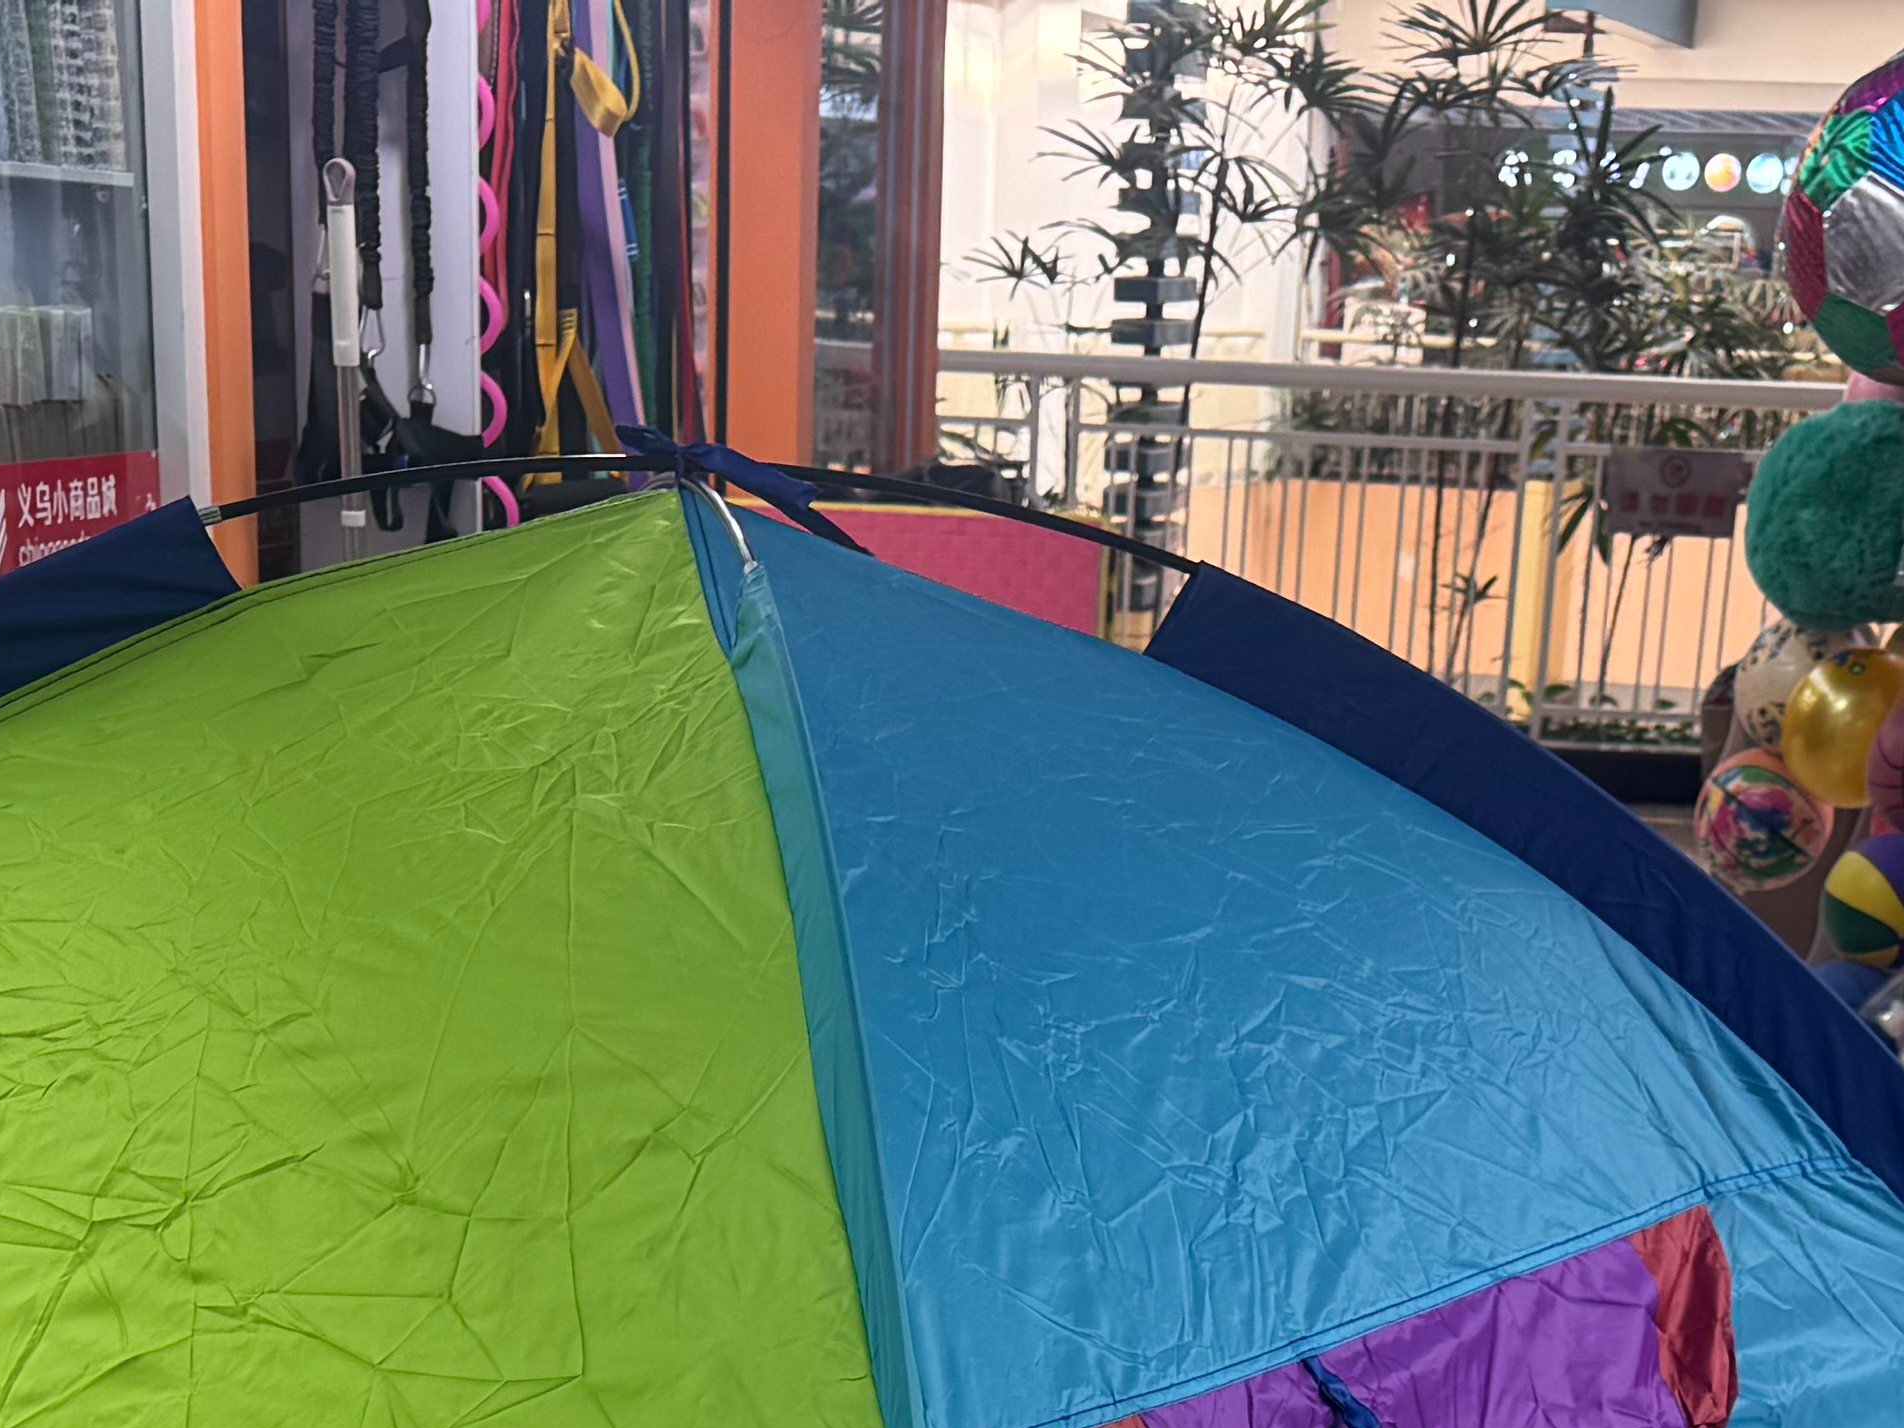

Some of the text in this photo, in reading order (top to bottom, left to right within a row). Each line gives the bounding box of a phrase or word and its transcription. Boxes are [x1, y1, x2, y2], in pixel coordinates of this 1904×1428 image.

[17, 473, 118, 529] 义乌小商品城
